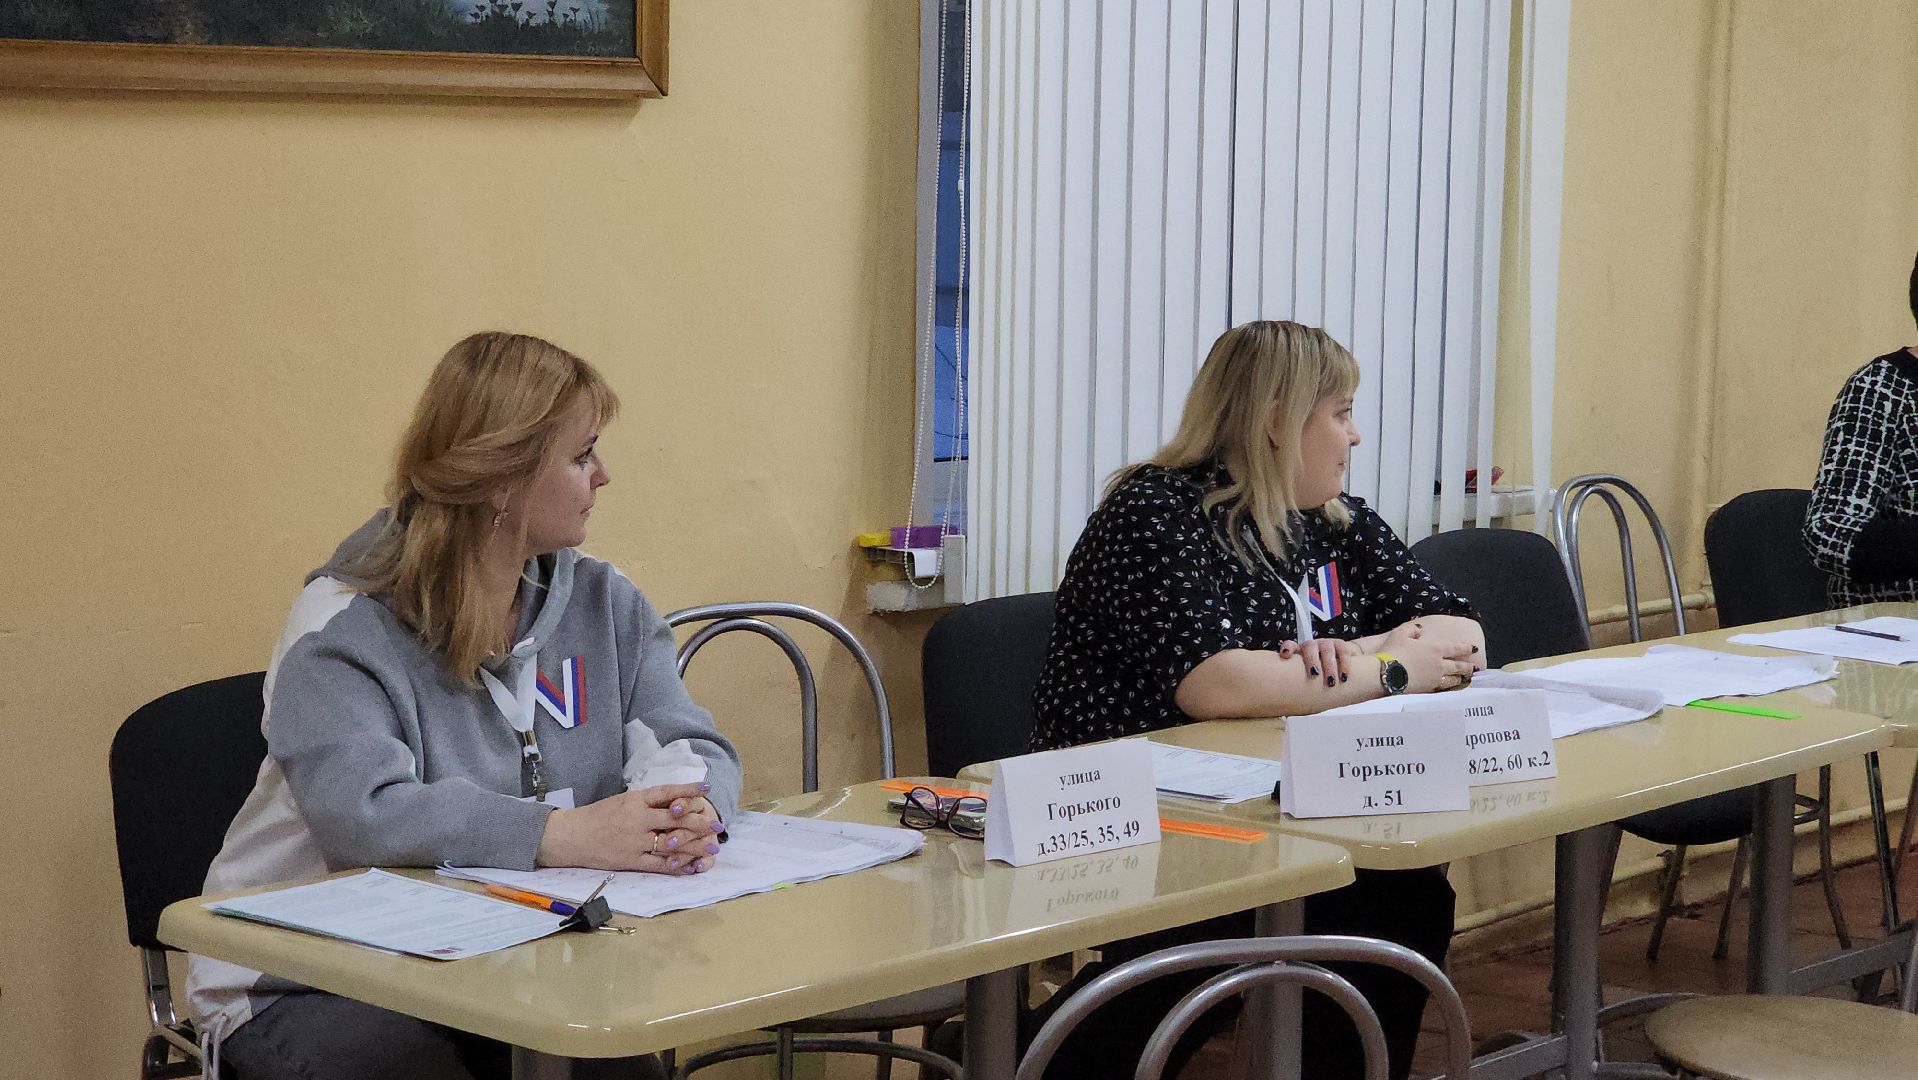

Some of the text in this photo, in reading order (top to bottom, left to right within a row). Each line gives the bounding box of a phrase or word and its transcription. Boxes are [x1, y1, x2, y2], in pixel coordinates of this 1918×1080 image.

[1464, 705, 1494, 718] лица
[1356, 735, 1404, 751] улица
[1465, 729, 1521, 750] ропова
[1338, 761, 1426, 781] Горького
[1468, 750, 1551, 775] 8/22, 60 к.2
[1059, 769, 1101, 790] улица
[1384, 789, 1404, 806] 51
[1047, 795, 1121, 822] Горького
[1037, 819, 1140, 857] д.33/25, 35, 49
